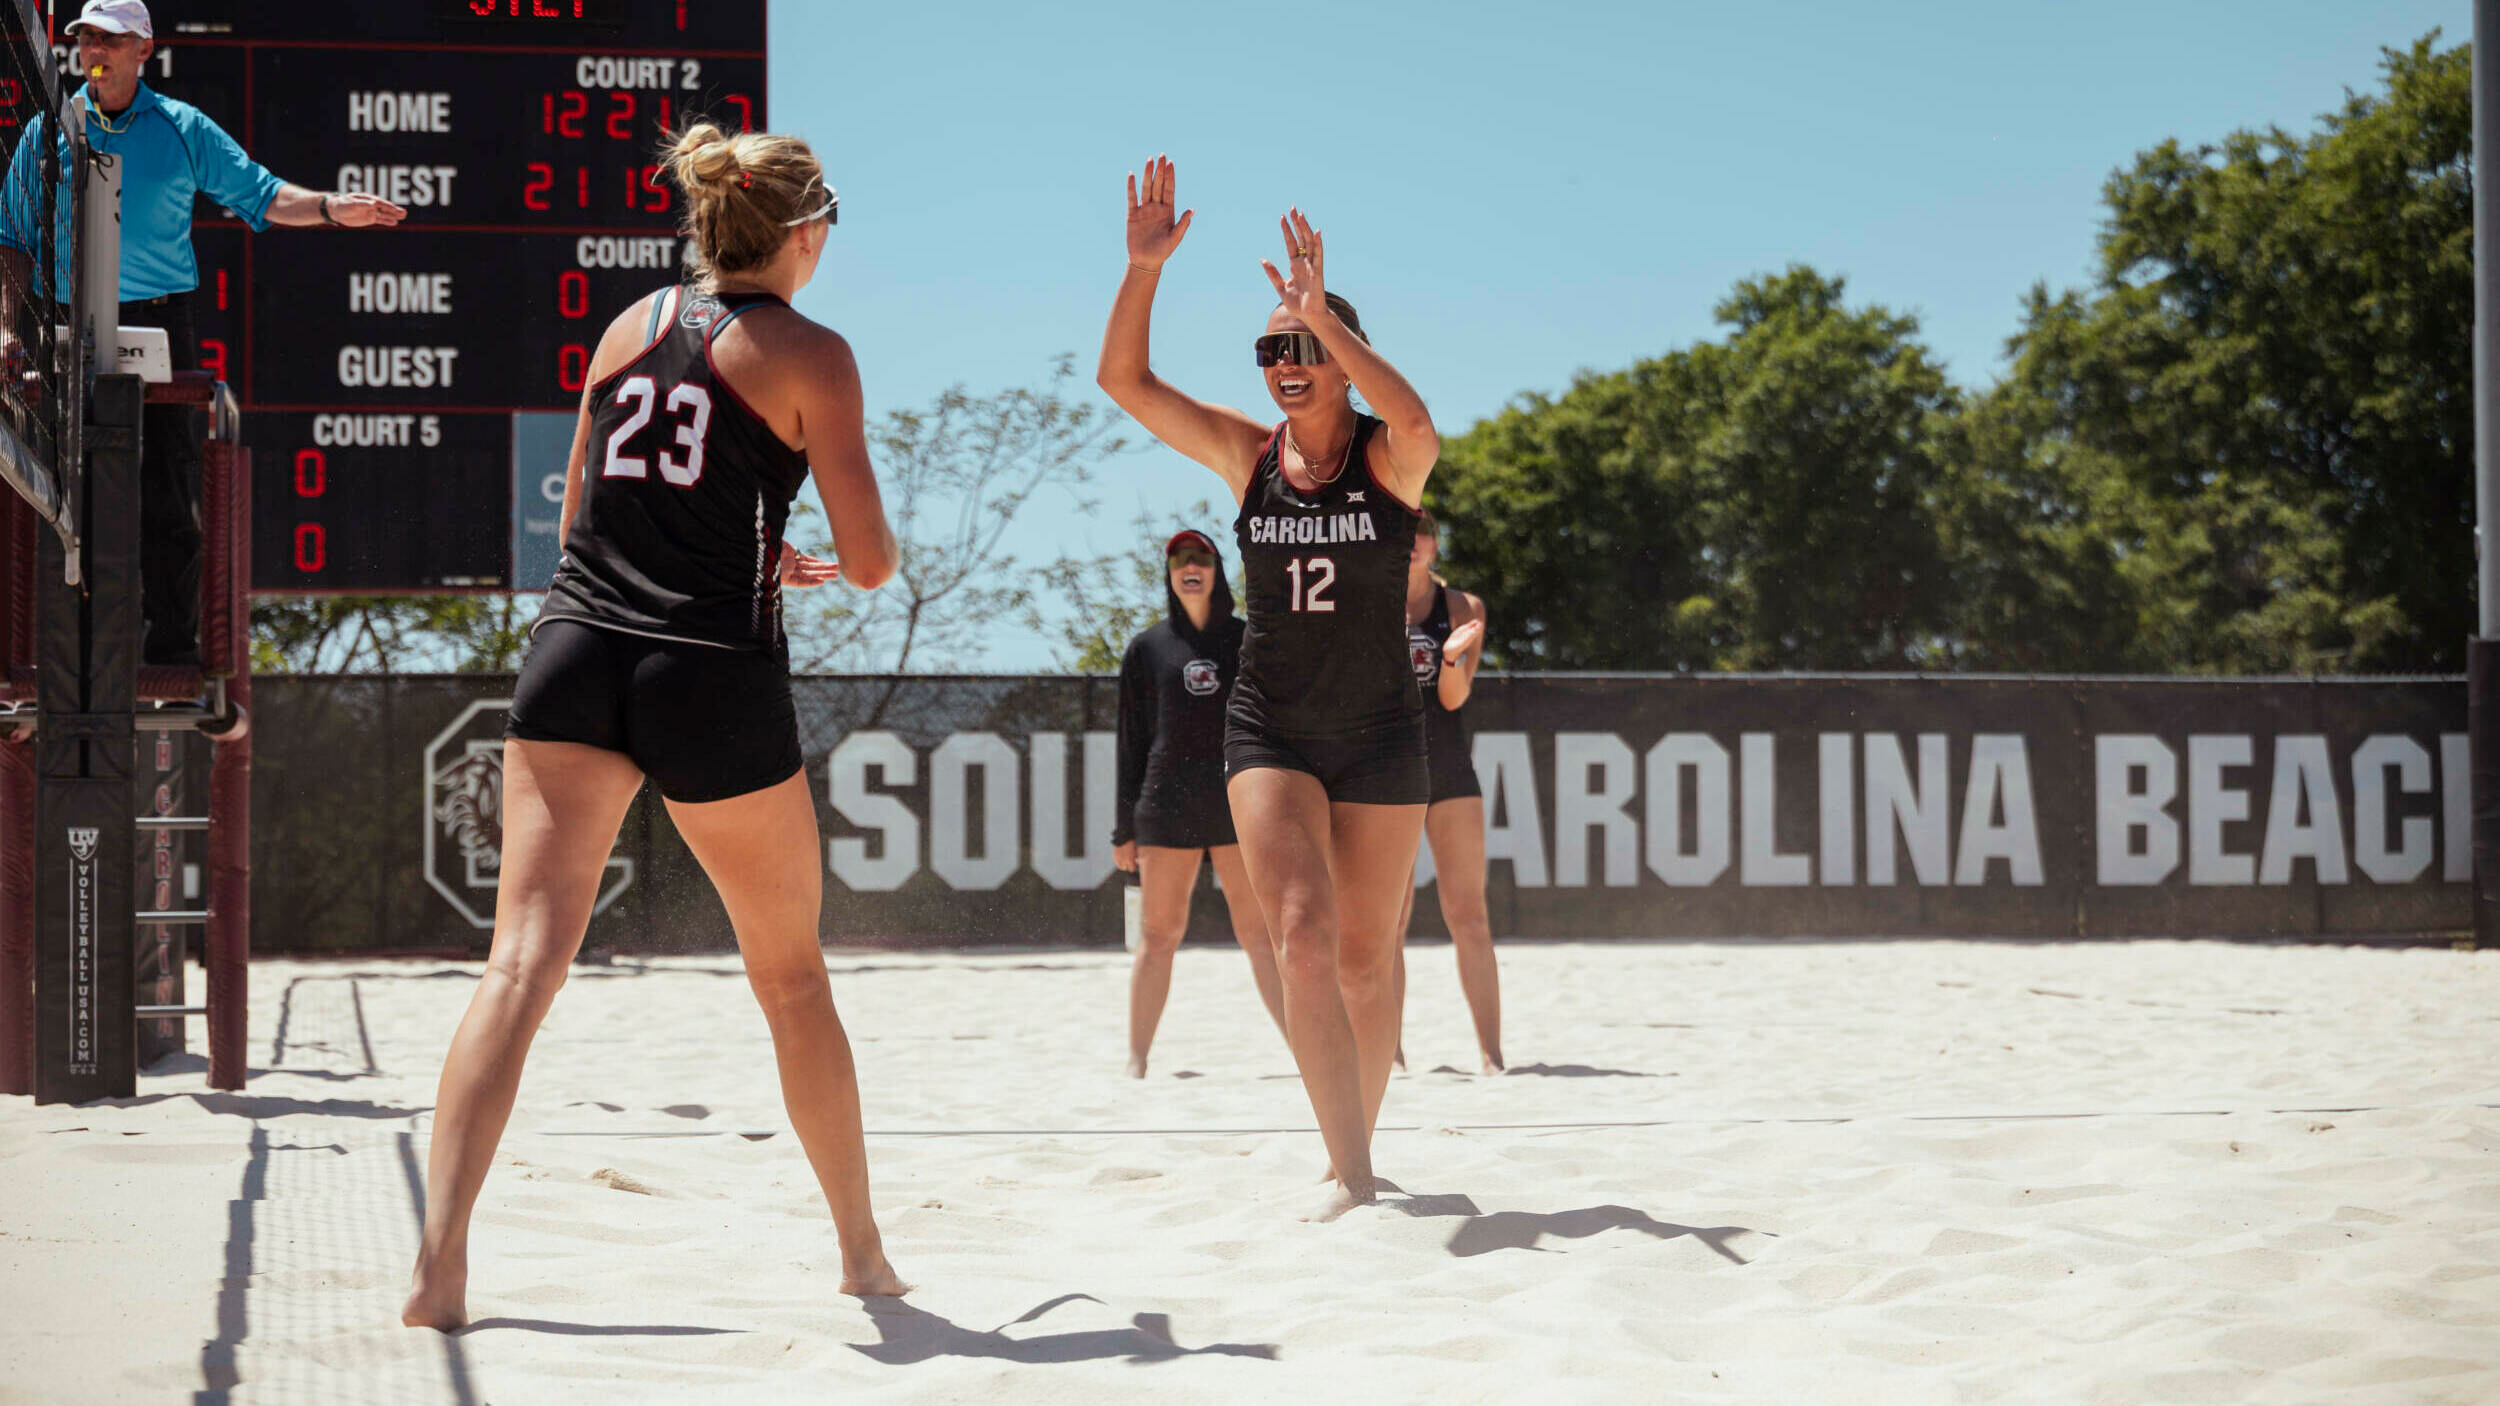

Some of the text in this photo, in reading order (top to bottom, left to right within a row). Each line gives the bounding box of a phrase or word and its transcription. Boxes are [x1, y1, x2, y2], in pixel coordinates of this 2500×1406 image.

[576, 56, 700, 90] COURT 2
[348, 92, 451, 132] HOME
[543, 91, 588, 138] 12
[337, 164, 457, 206] GUEST
[577, 236, 676, 269] COURT
[349, 272, 452, 314] HOME
[559, 270, 589, 319] 0
[338, 345, 458, 388] GUEST
[559, 343, 587, 392] 0
[313, 415, 441, 447] COURT 5
[602, 376, 713, 487] 23
[295, 448, 326, 498] 0
[295, 523, 326, 572] 0
[1249, 512, 1377, 544] CAROLINA
[1286, 557, 1336, 612] 12
[828, 730, 1118, 892] SOU
[1414, 731, 2045, 888] AROLINA
